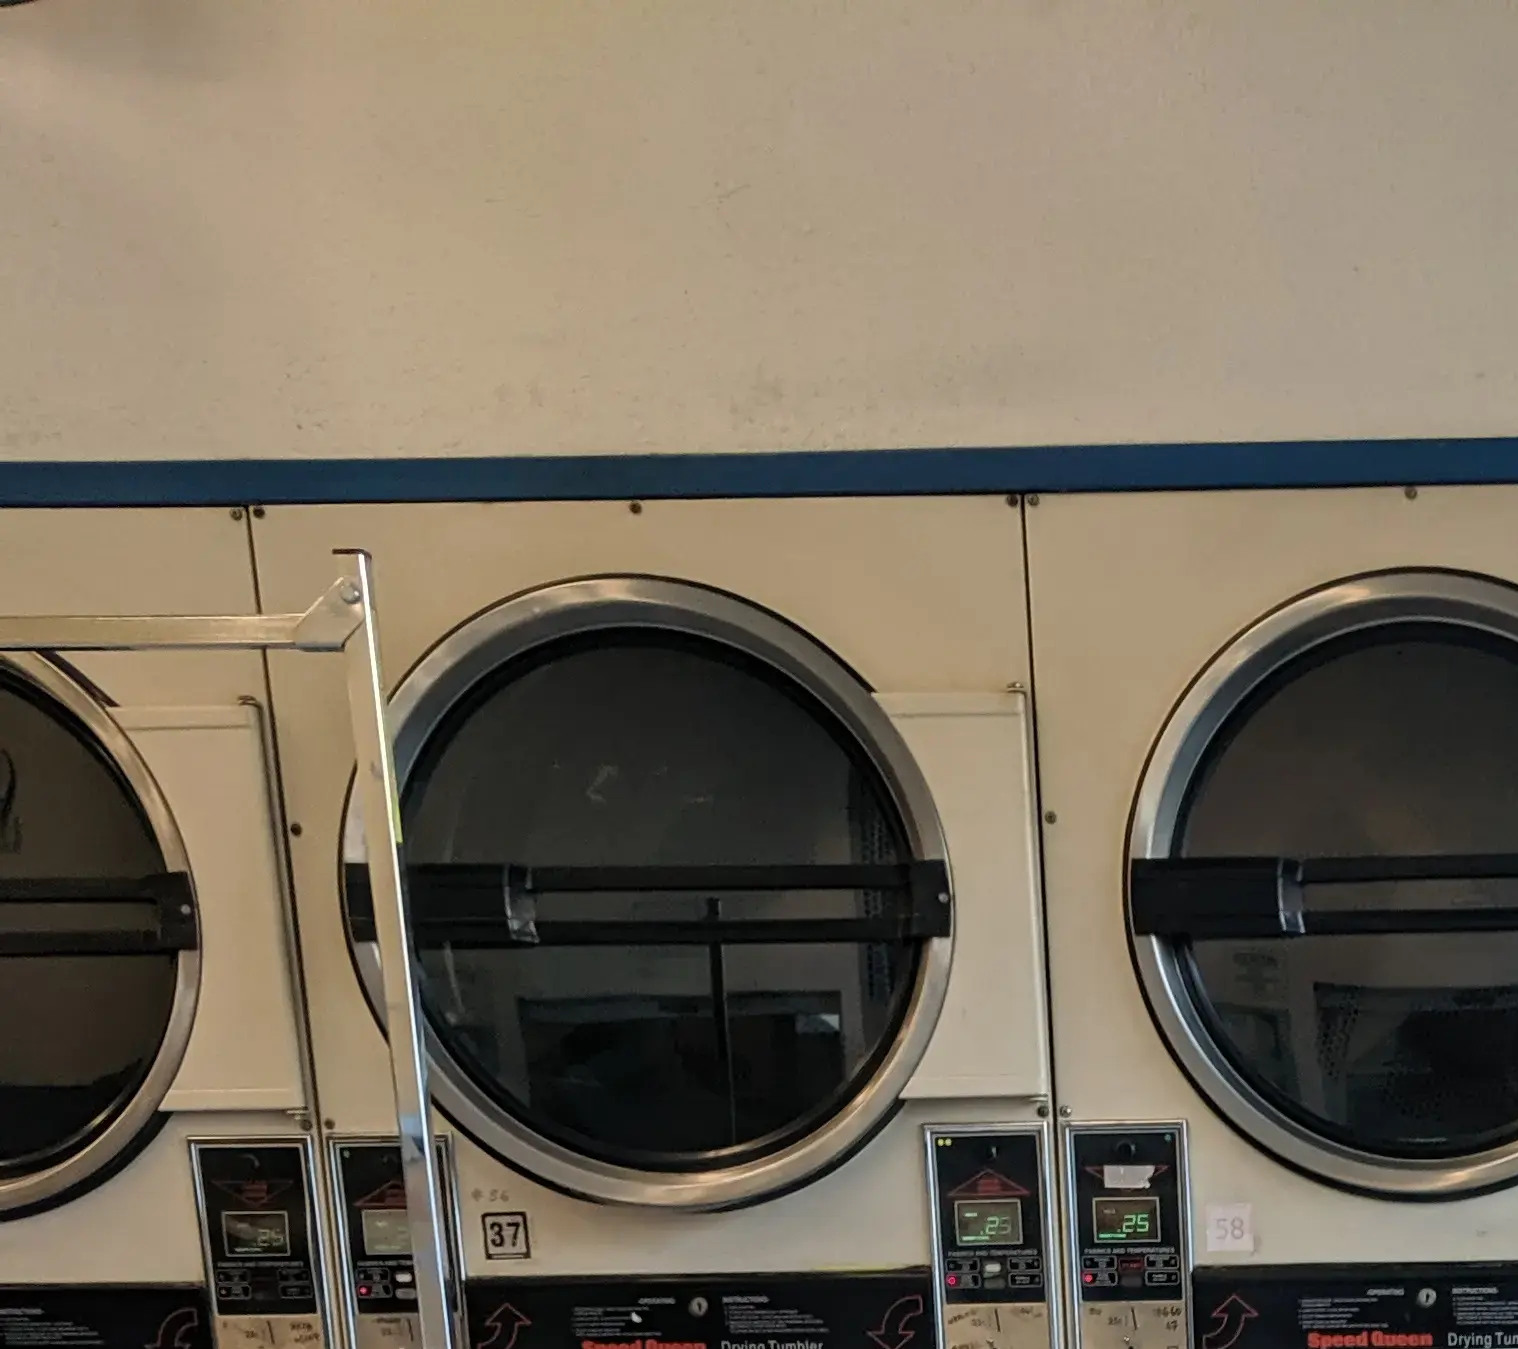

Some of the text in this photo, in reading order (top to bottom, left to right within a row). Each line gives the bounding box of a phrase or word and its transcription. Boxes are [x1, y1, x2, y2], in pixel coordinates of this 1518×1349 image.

[1117, 1213, 1149, 1233] .25
[1216, 1216, 1244, 1240] 58
[490, 1222, 520, 1247] 37
[1370, 1330, 1433, 1349] Queen
[1447, 1333, 1492, 1349] Drying
